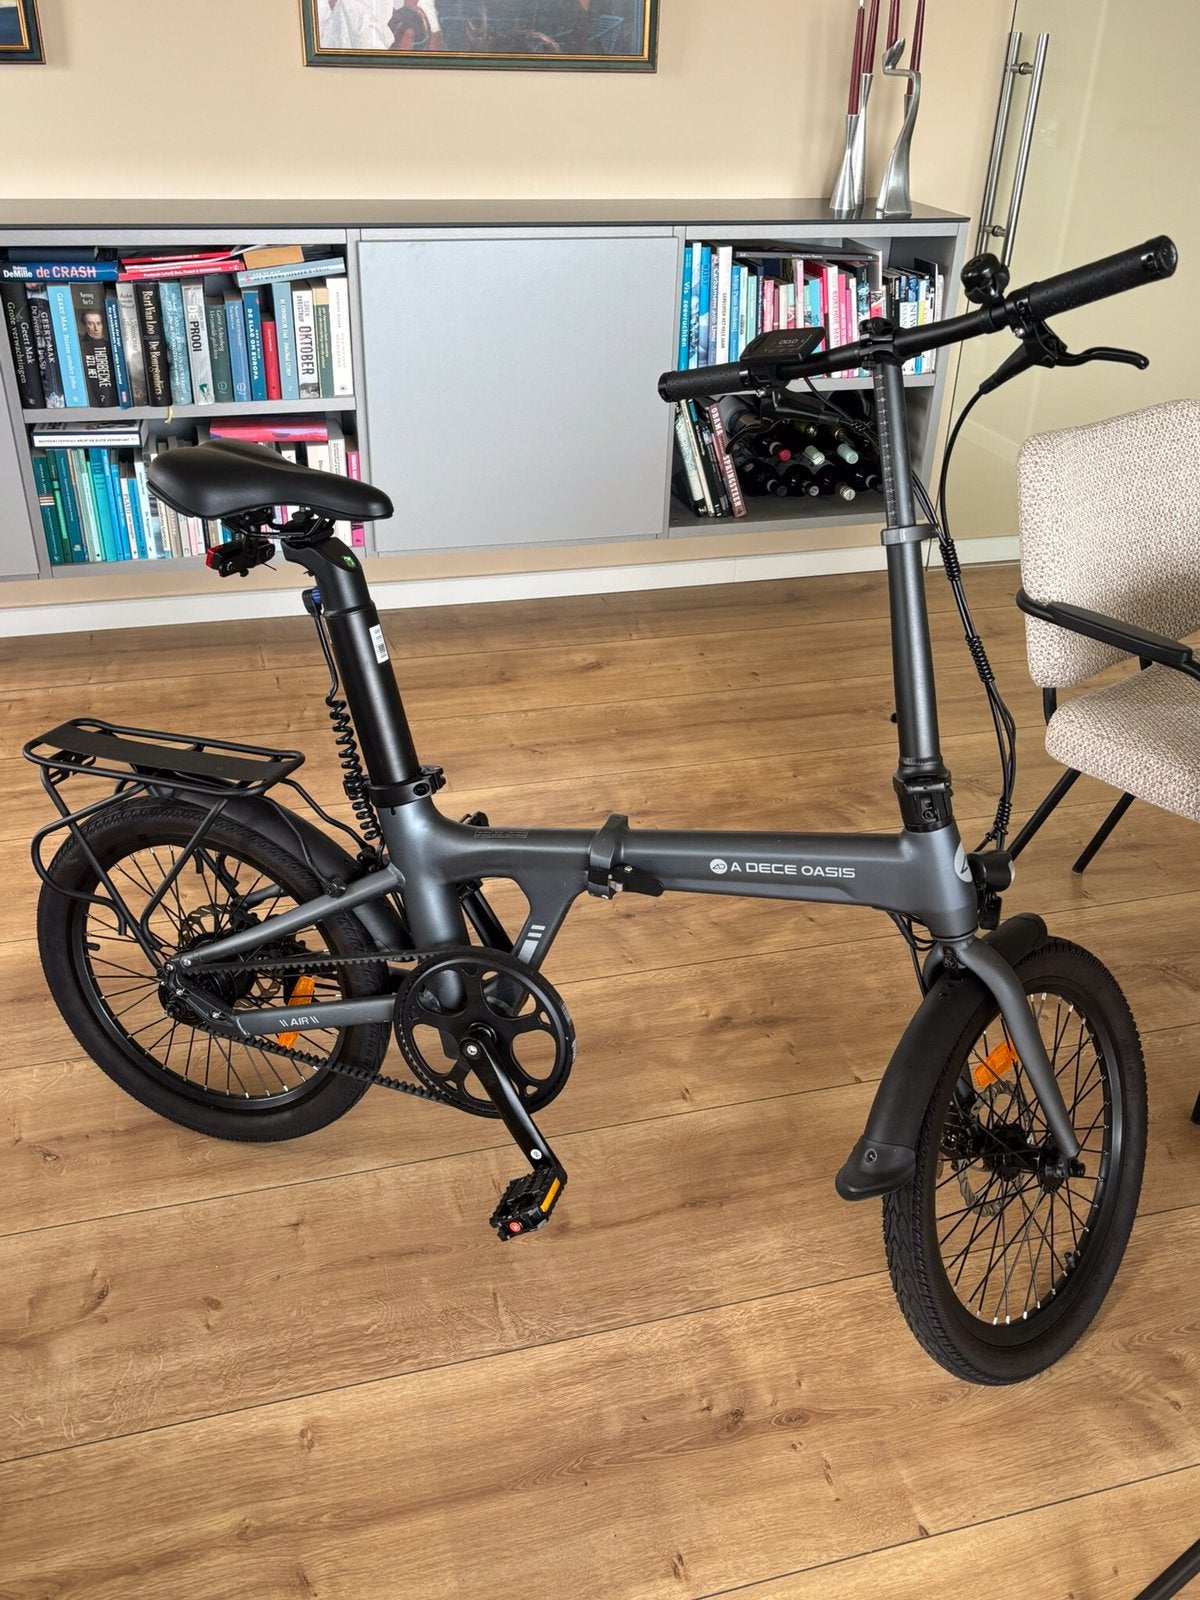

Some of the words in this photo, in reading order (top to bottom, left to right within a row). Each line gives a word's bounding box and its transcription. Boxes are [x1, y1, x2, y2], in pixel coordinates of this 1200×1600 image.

[3, 270, 33, 278] DeMille
[36, 266, 50, 278] de
[52, 266, 96, 278] CRASH
[142, 291, 153, 306] Bart
[7, 302, 16, 325] Grote
[31, 306, 38, 315] De
[145, 306, 156, 320] Van
[188, 305, 199, 319] DE
[20, 322, 30, 345] Geert
[33, 316, 41, 336] levens
[41, 312, 51, 340] GEERT
[146, 321, 157, 334] Loo
[247, 309, 253, 318] DE
[250, 339, 256, 350] OM
[189, 321, 202, 352] PROOI
[148, 341, 160, 350] De
[298, 325, 315, 375] OKTOBER
[10, 328, 28, 384] verwachtingen
[24, 346, 35, 364] Mak
[45, 346, 55, 363] MAK
[88, 369, 97, 379] HET
[94, 346, 112, 388] THORBECKE
[711, 407, 722, 436] OBAMA
[722, 454, 742, 507] SPRINGSTEEN
[730, 862, 742, 872] A
[746, 862, 797, 875] DECE
[801, 866, 855, 878] OASIS
[290, 1016, 309, 1026] AIR
